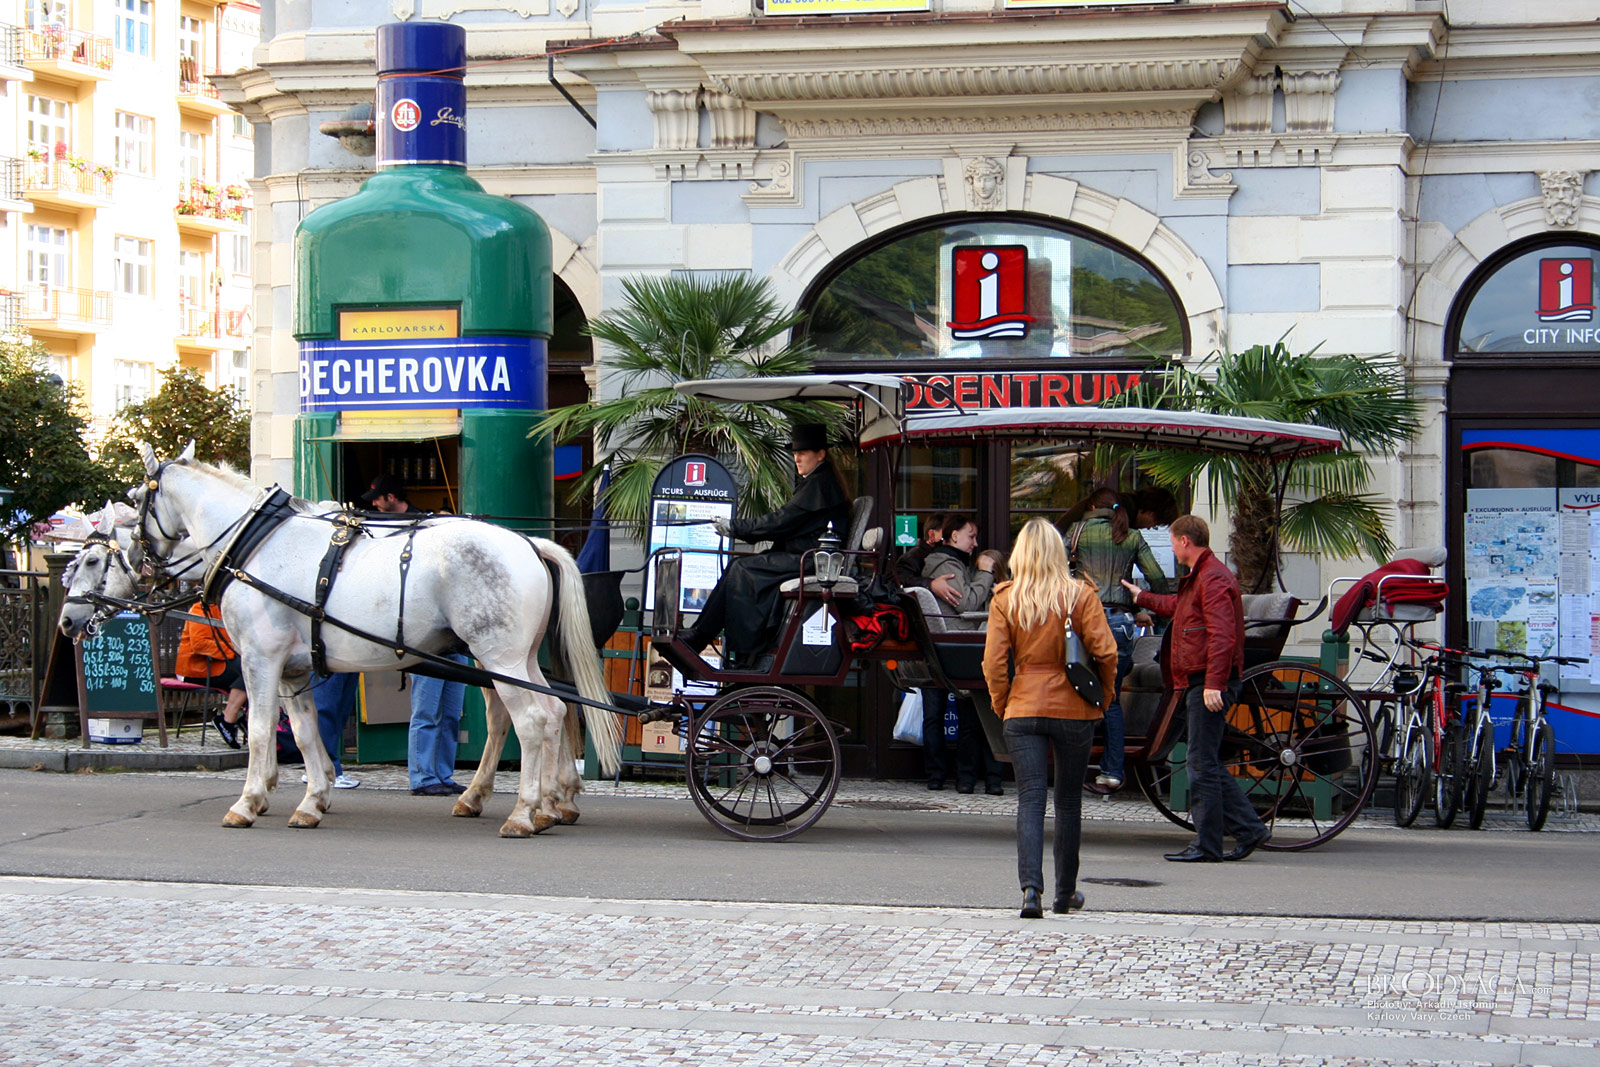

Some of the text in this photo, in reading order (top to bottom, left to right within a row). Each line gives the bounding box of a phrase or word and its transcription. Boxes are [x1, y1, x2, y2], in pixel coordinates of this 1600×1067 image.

[352, 323, 445, 334] KARLOVARSKÁ
[1523, 329, 1559, 344] CITY
[299, 356, 511, 397] BECHEROVKA
[693, 488, 729, 497] AUSFLÜGE
